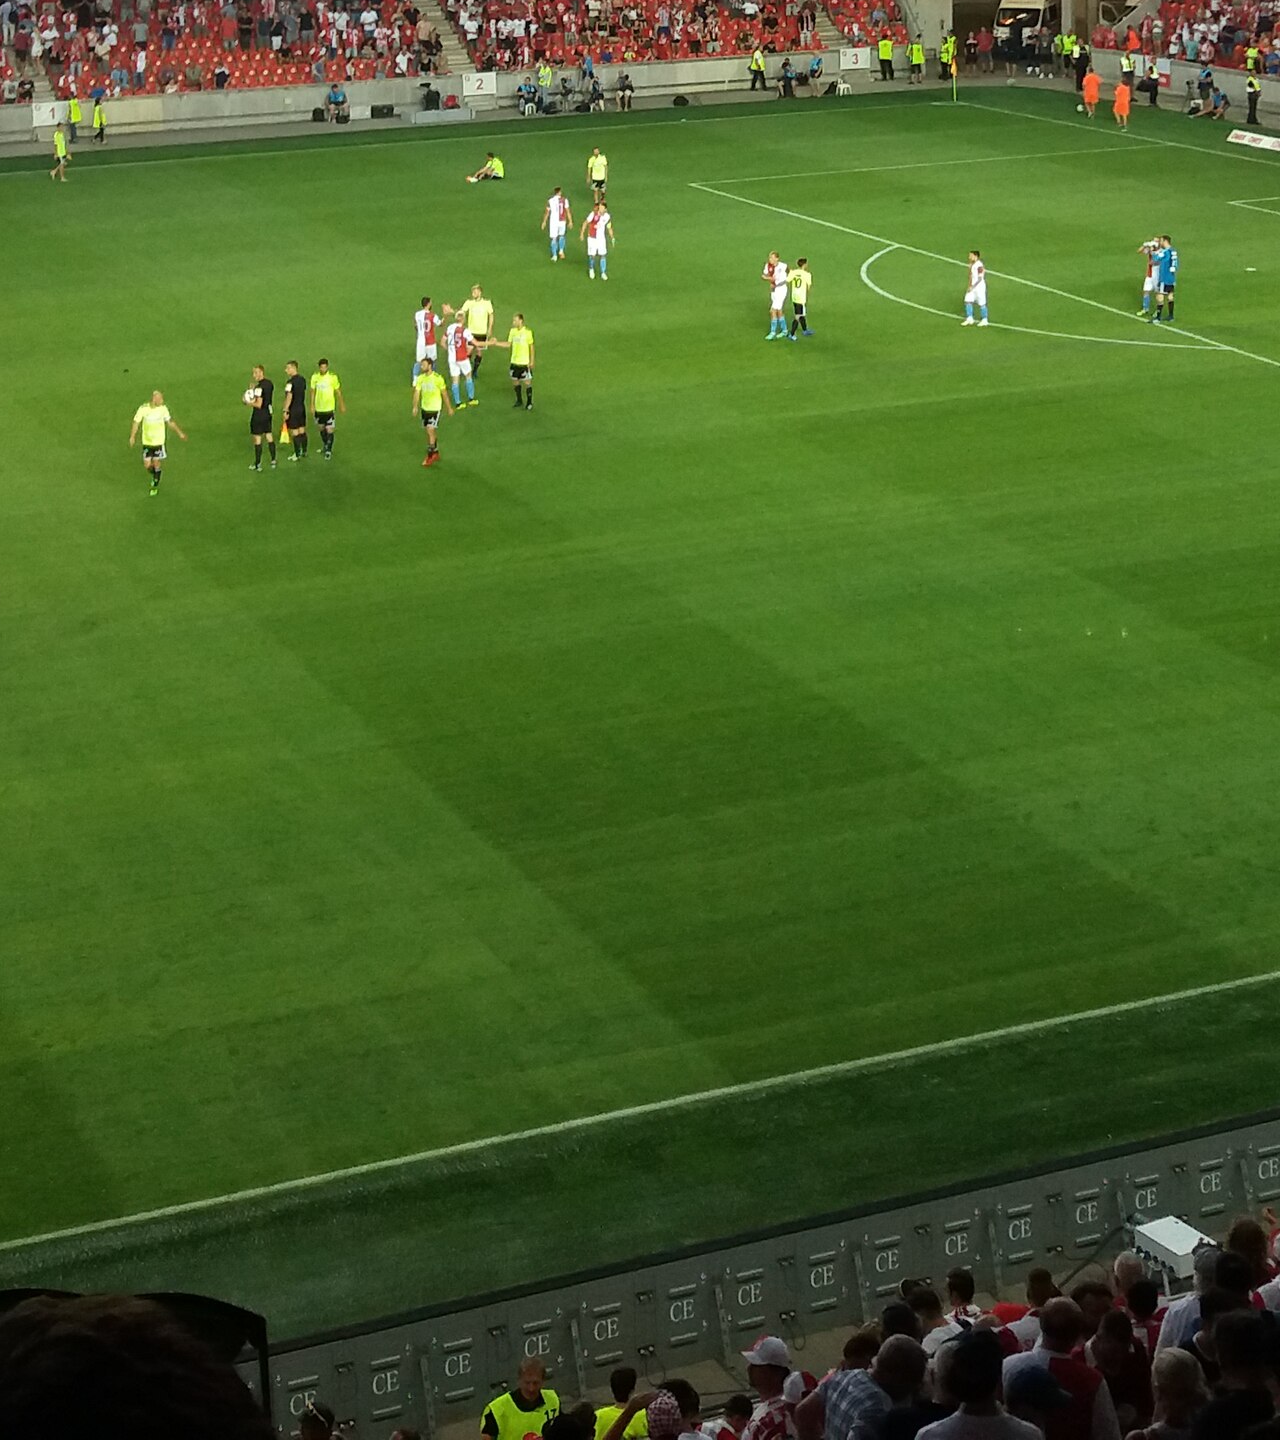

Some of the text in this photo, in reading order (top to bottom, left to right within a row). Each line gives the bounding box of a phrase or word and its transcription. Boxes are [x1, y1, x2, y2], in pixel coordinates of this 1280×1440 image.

[852, 53, 859, 65] 3
[475, 78, 484, 90] 2
[49, 106, 56, 120] 1
[1258, 1158, 1280, 1180] CE
[1200, 1172, 1223, 1195] CE
[1135, 1187, 1159, 1211] CE
[1075, 1201, 1099, 1225] CE
[1008, 1217, 1032, 1242] CE
[945, 1232, 970, 1256] CE
[875, 1249, 900, 1273] CE
[810, 1265, 836, 1289] CE
[736, 1282, 763, 1307] CE
[669, 1298, 696, 1323] CE
[593, 1317, 620, 1342] CE
[524, 1333, 551, 1359] CE
[444, 1352, 472, 1378] CE
[372, 1370, 400, 1396] CE
[544, 1408, 557, 1421] 17
